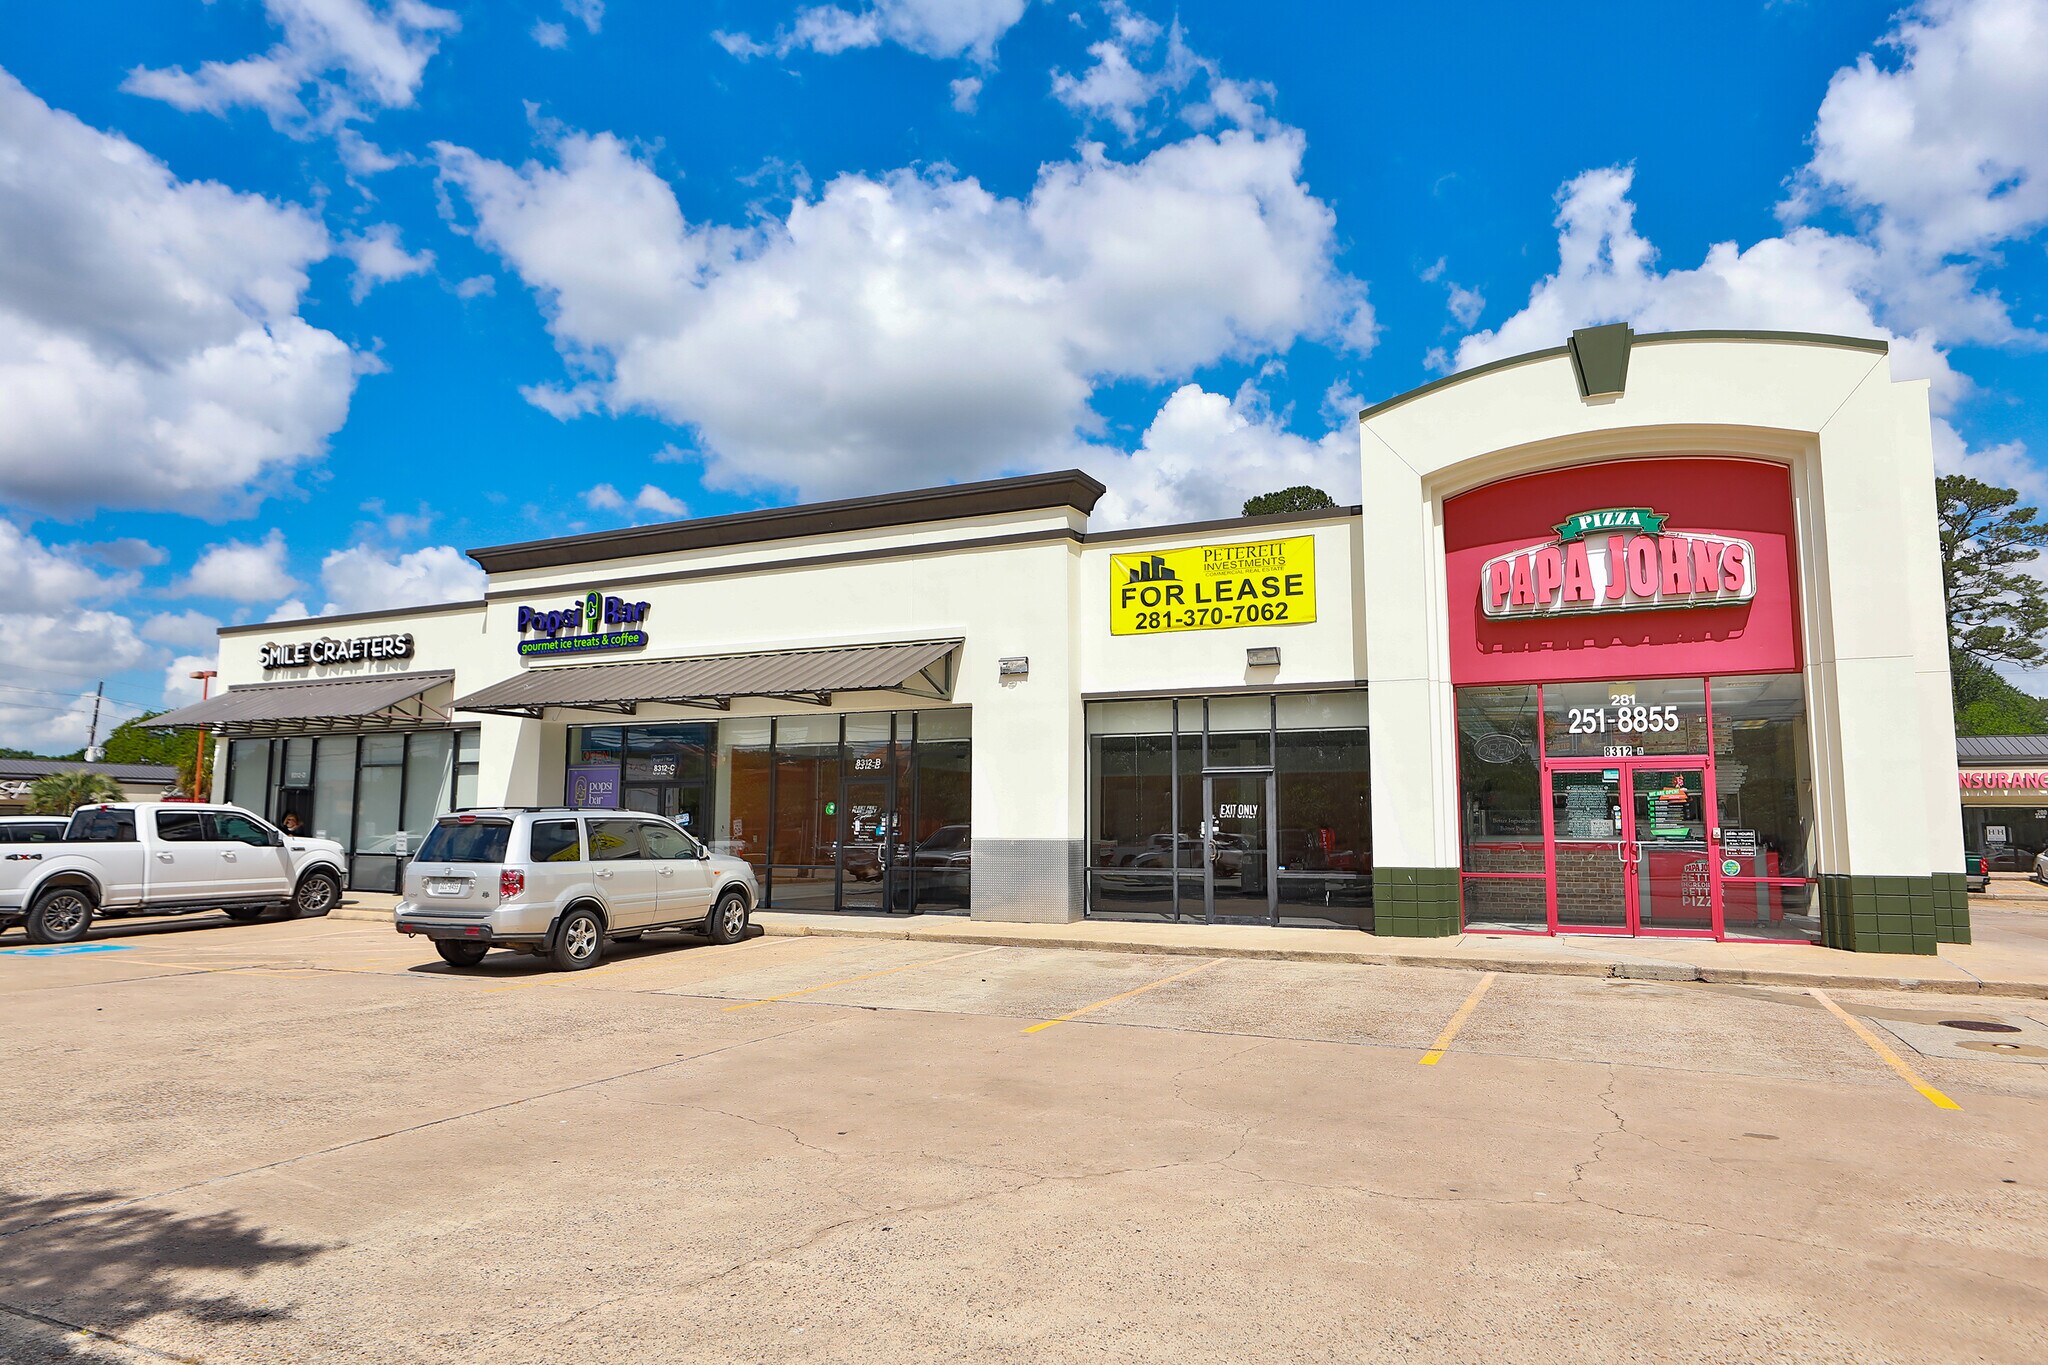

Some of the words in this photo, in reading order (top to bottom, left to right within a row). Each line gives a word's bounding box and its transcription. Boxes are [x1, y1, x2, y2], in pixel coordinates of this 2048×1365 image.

[1577, 511, 1641, 531] PIZZA
[1203, 543, 1286, 562] PETEREIT
[1203, 556, 1286, 571] INVESTMENTS
[1489, 540, 1596, 607] PAPA
[1605, 534, 1745, 600] JOHNS
[1121, 584, 1185, 609] FOR
[1195, 573, 1304, 604] LEASE
[518, 600, 584, 638] Popsi
[605, 596, 650, 624] Bar
[1135, 601, 1289, 630] 281-370-7062
[521, 639, 559, 654] gourmet
[560, 639, 572, 649] ice
[573, 636, 600, 648] treats
[601, 634, 609, 645] &
[610, 632, 640, 646] coffee
[1611, 694, 1636, 706] 281
[1568, 705, 1680, 734] 251-8855
[1604, 746, 1632, 757] 8312
[653, 764, 675, 773] 8312-C
[855, 758, 881, 767] 8312-B
[589, 780, 613, 793] popsi
[588, 794, 604, 805] bar
[1220, 804, 1237, 815] EXIT
[1238, 804, 1258, 815] ONLY
